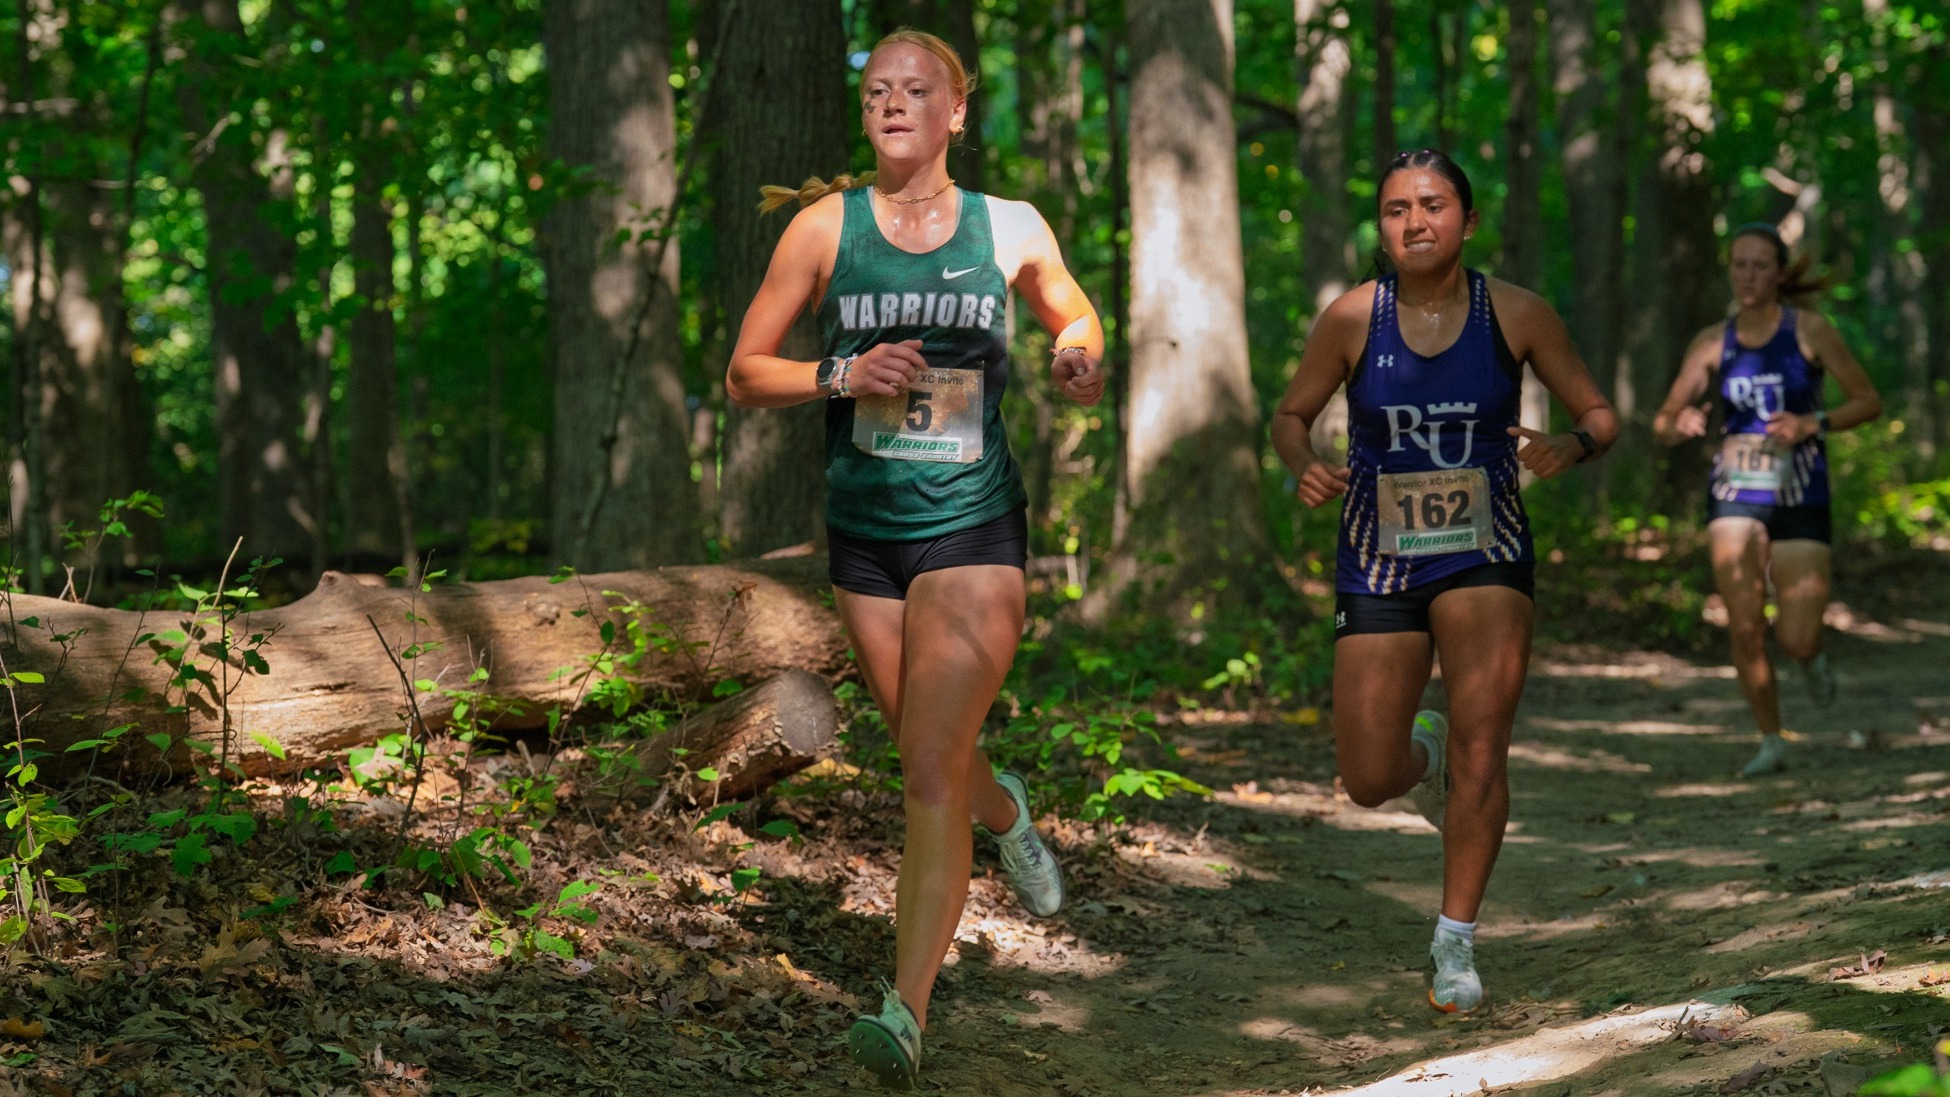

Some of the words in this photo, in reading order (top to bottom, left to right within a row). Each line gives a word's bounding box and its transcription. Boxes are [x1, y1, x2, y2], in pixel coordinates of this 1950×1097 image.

[838, 292, 996, 330] WARRIORS
[920, 374, 935, 384] XC
[938, 375, 964, 386] Invite
[1728, 375, 1785, 422] RU
[906, 391, 933, 432] 5
[875, 433, 959, 452] WARRIORS
[1380, 404, 1480, 469] RU
[1394, 480, 1426, 489] Warrior
[1429, 477, 1442, 486] XC
[1445, 474, 1470, 484] Invite
[1397, 490, 1471, 530] 162
[1399, 533, 1474, 550] WARRIORS
